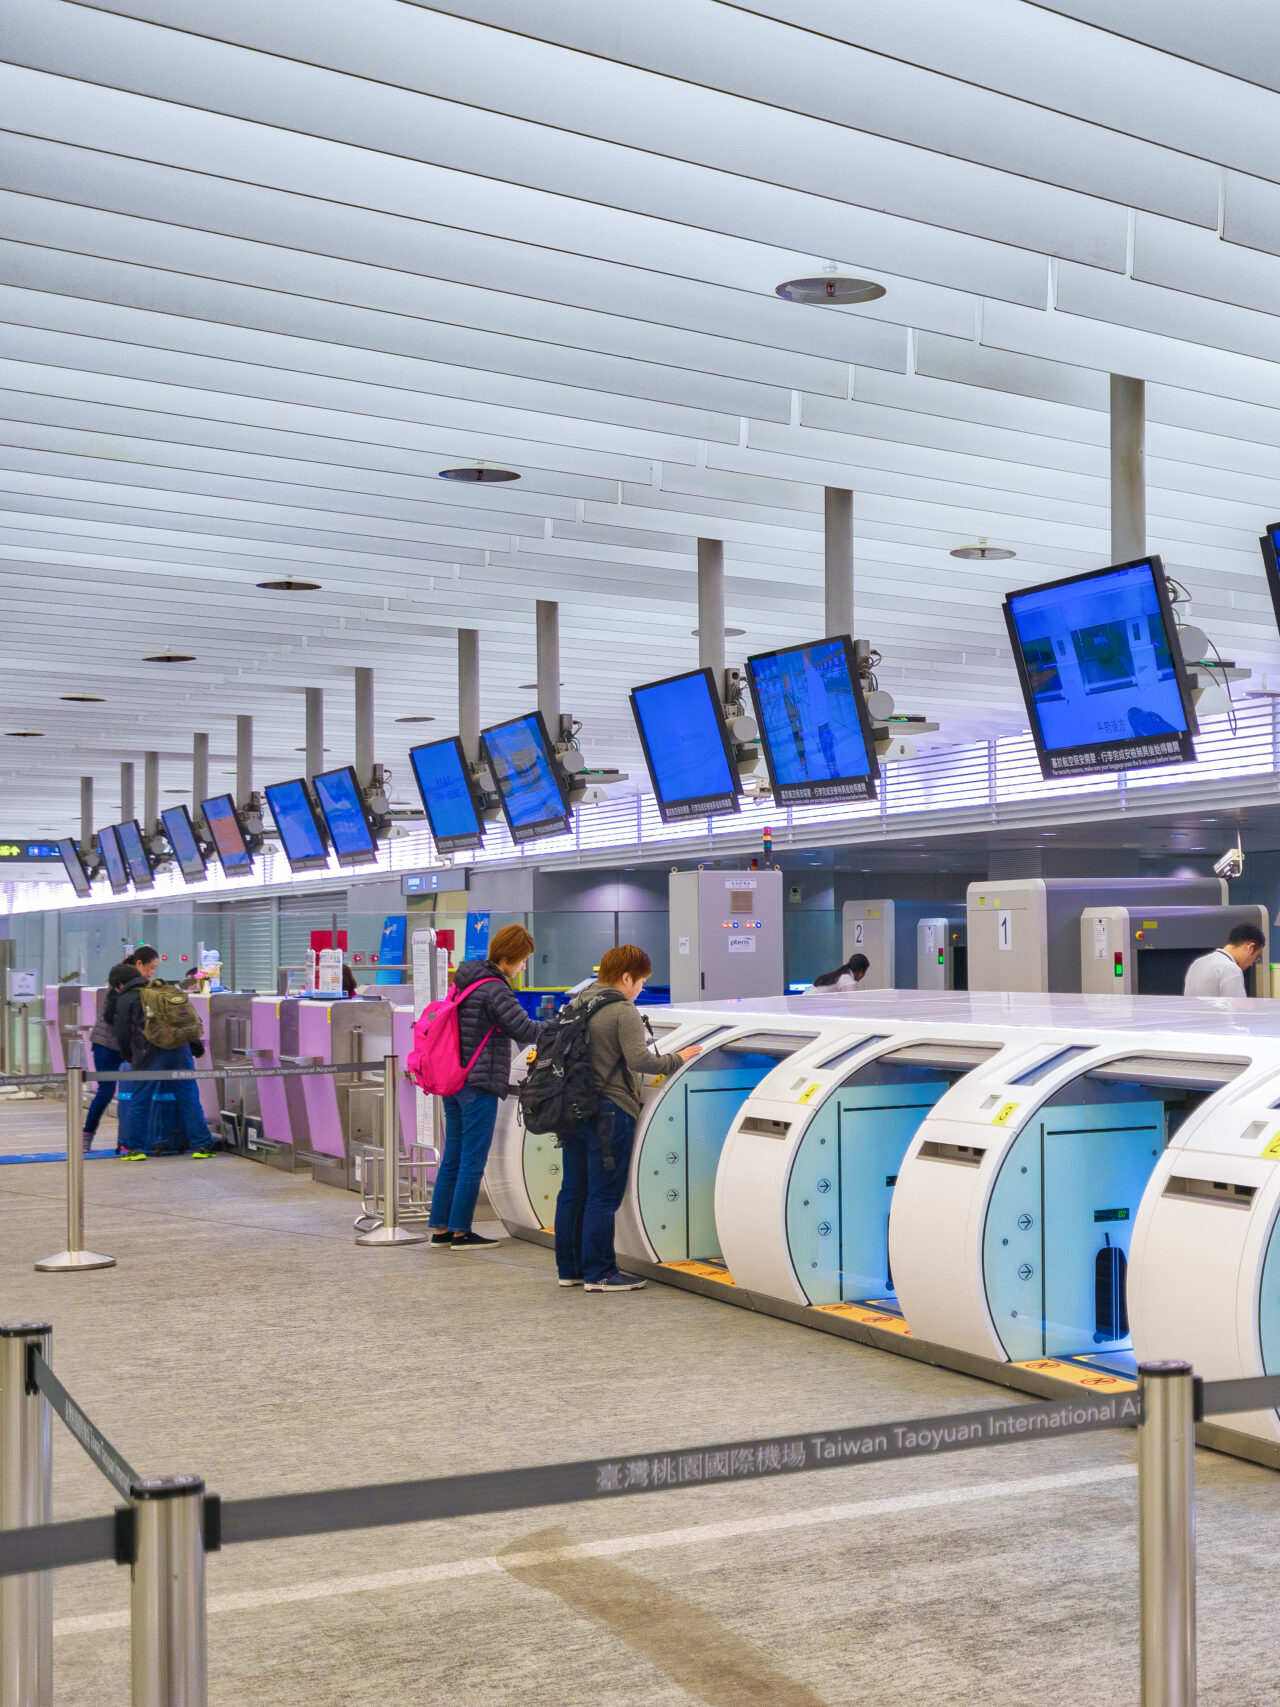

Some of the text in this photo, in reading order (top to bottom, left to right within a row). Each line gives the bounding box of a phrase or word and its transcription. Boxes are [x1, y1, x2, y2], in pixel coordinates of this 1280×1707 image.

[855, 924, 863, 943] 2
[1001, 917, 1008, 945] 1
[999, 1106, 1013, 1121] 3
[595, 1440, 807, 1493] 臺灣桃園國際機場
[811, 1432, 888, 1461] Taiwan
[893, 1420, 983, 1455] Taoyuan
[988, 1400, 1117, 1437] International
